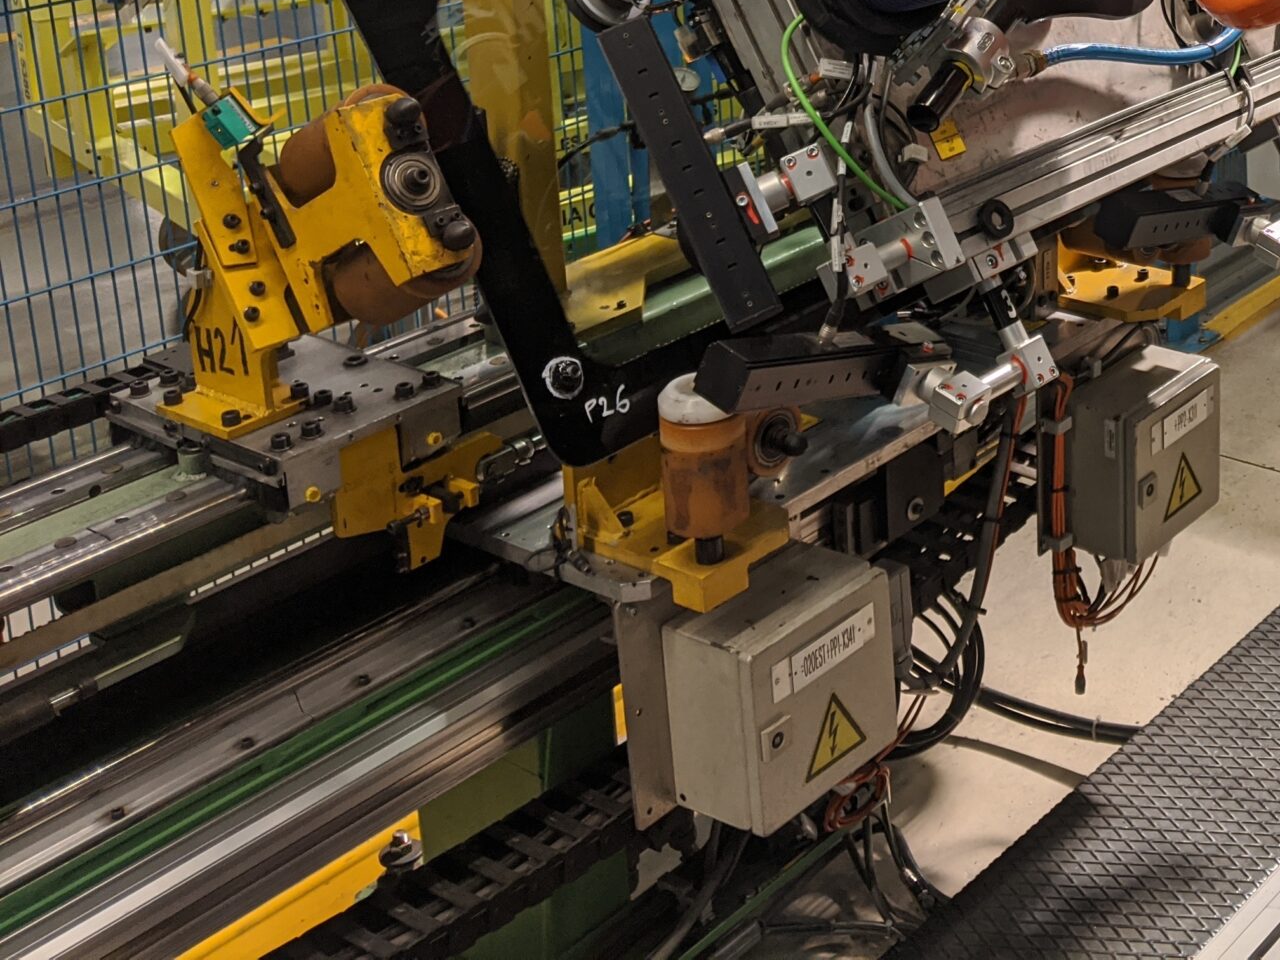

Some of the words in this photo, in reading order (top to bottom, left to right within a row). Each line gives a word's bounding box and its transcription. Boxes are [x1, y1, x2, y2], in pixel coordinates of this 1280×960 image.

[1000, 289, 1017, 319] 3
[194, 315, 250, 377] H21
[584, 383, 631, 424] P26
